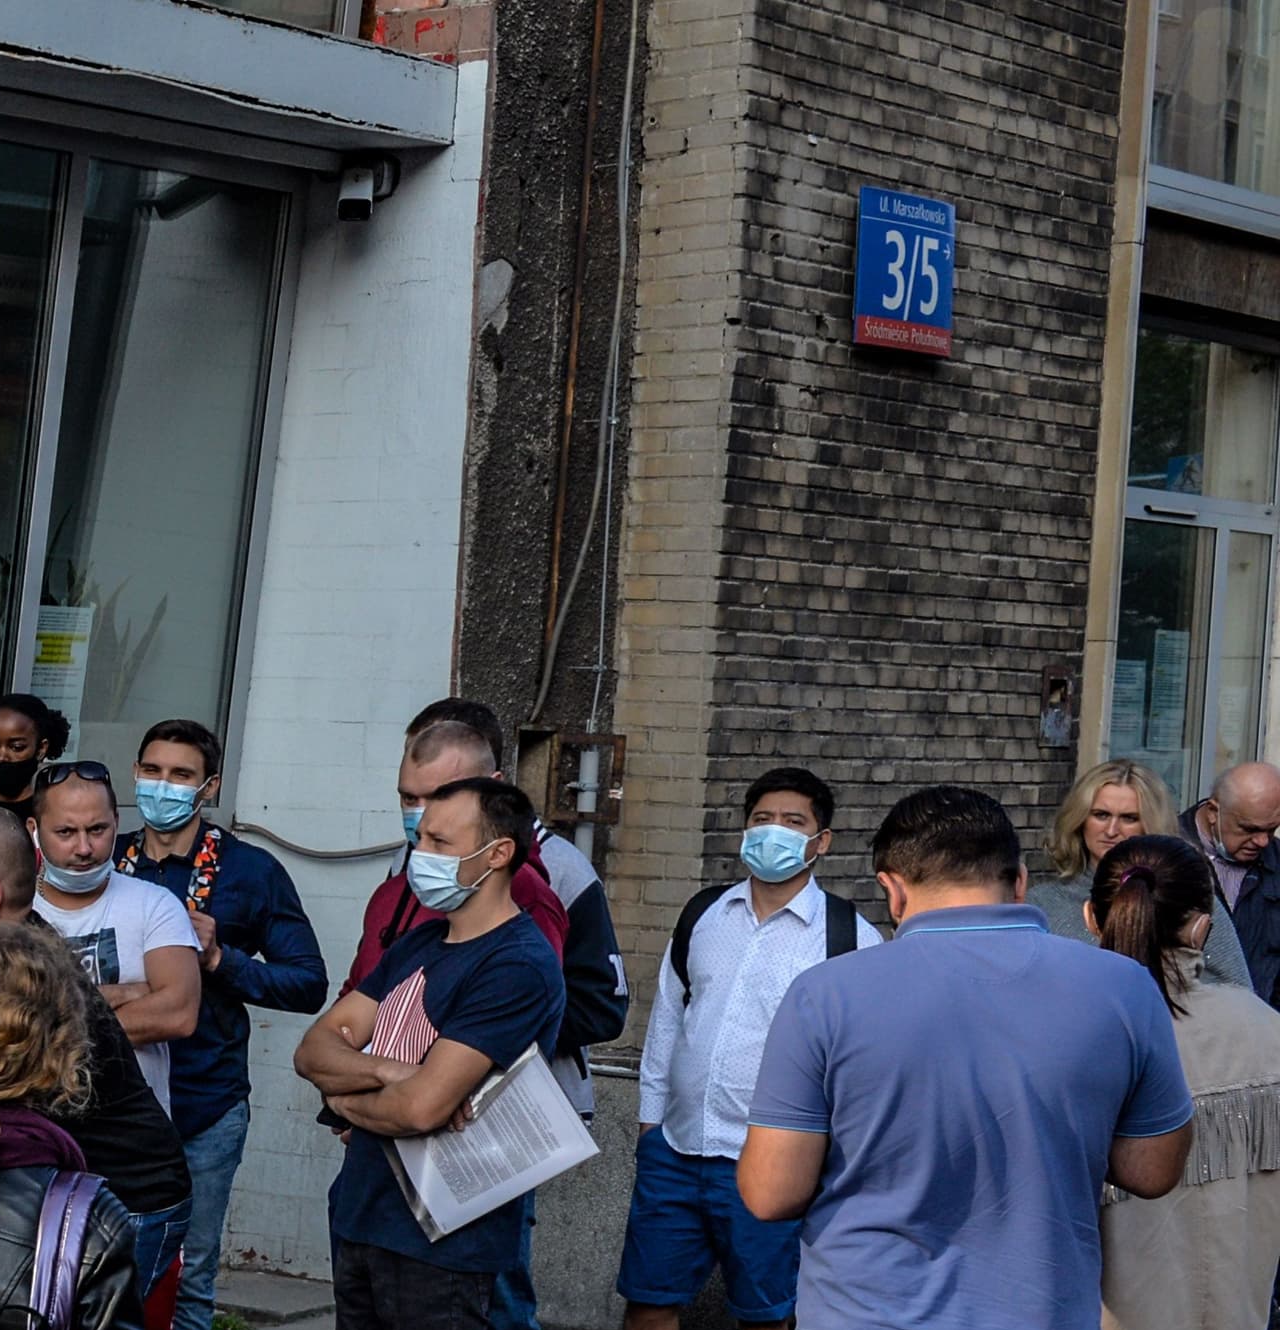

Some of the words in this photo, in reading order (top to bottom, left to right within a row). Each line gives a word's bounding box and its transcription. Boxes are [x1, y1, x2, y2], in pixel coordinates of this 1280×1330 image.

[893, 198, 946, 226] Marszałkowska
[882, 229, 939, 321] 3/5
[864, 315, 908, 343] Śródmieście
